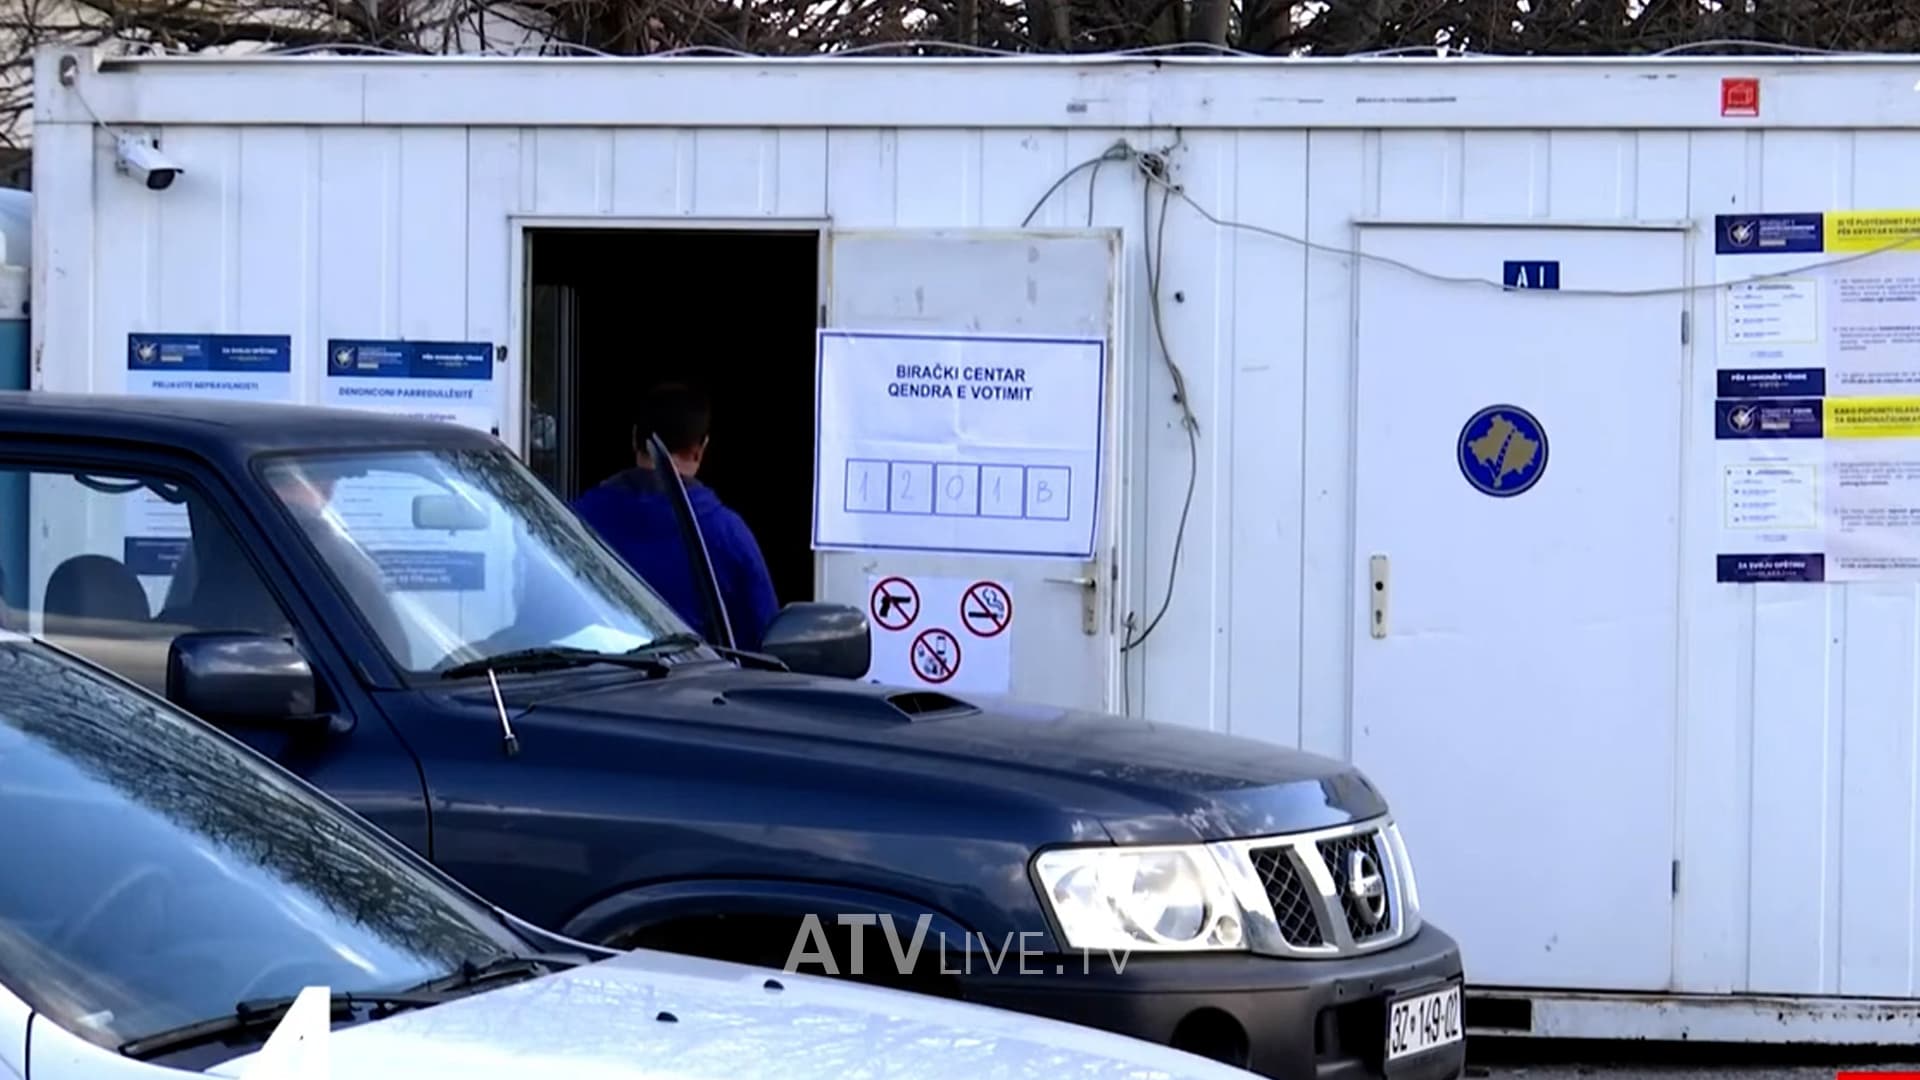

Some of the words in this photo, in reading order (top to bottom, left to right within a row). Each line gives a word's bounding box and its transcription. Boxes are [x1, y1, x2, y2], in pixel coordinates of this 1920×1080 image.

[896, 362, 959, 380] BIRAČKI
[963, 366, 1026, 382] CENTAR
[888, 383, 953, 399] QENDRA
[957, 386, 967, 399] E
[973, 386, 1033, 401] VOTIMIT
